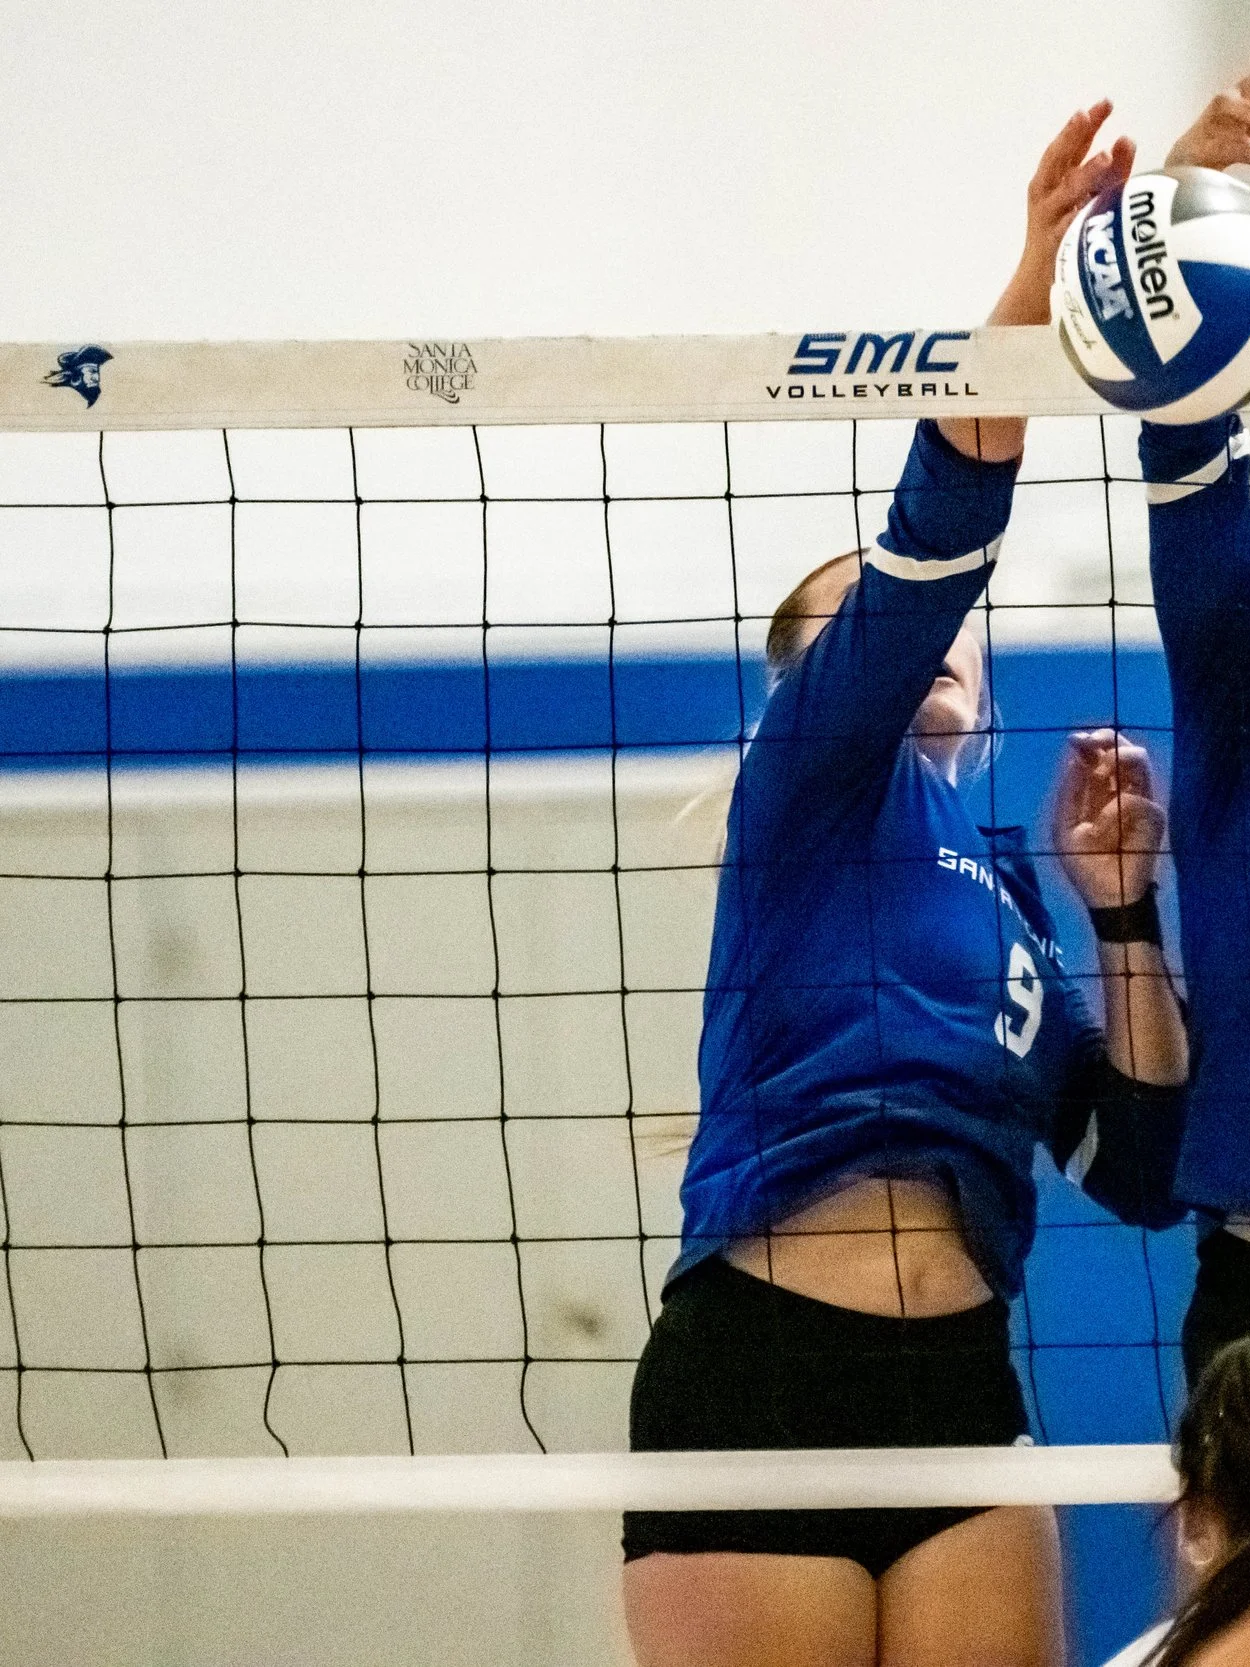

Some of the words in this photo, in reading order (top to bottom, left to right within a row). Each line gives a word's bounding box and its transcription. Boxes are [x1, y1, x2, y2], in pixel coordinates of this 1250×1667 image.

[1086, 210, 1132, 321] NCAA
[1128, 190, 1175, 321] molten
[402, 358, 478, 374] MONICA
[407, 342, 473, 358] SANTA
[787, 331, 971, 375] SMC
[406, 374, 475, 404] COLLEGE
[766, 382, 979, 399] VOLLEYBALL
[937, 846, 1014, 911] SANA
[994, 942, 1044, 1058] 9
